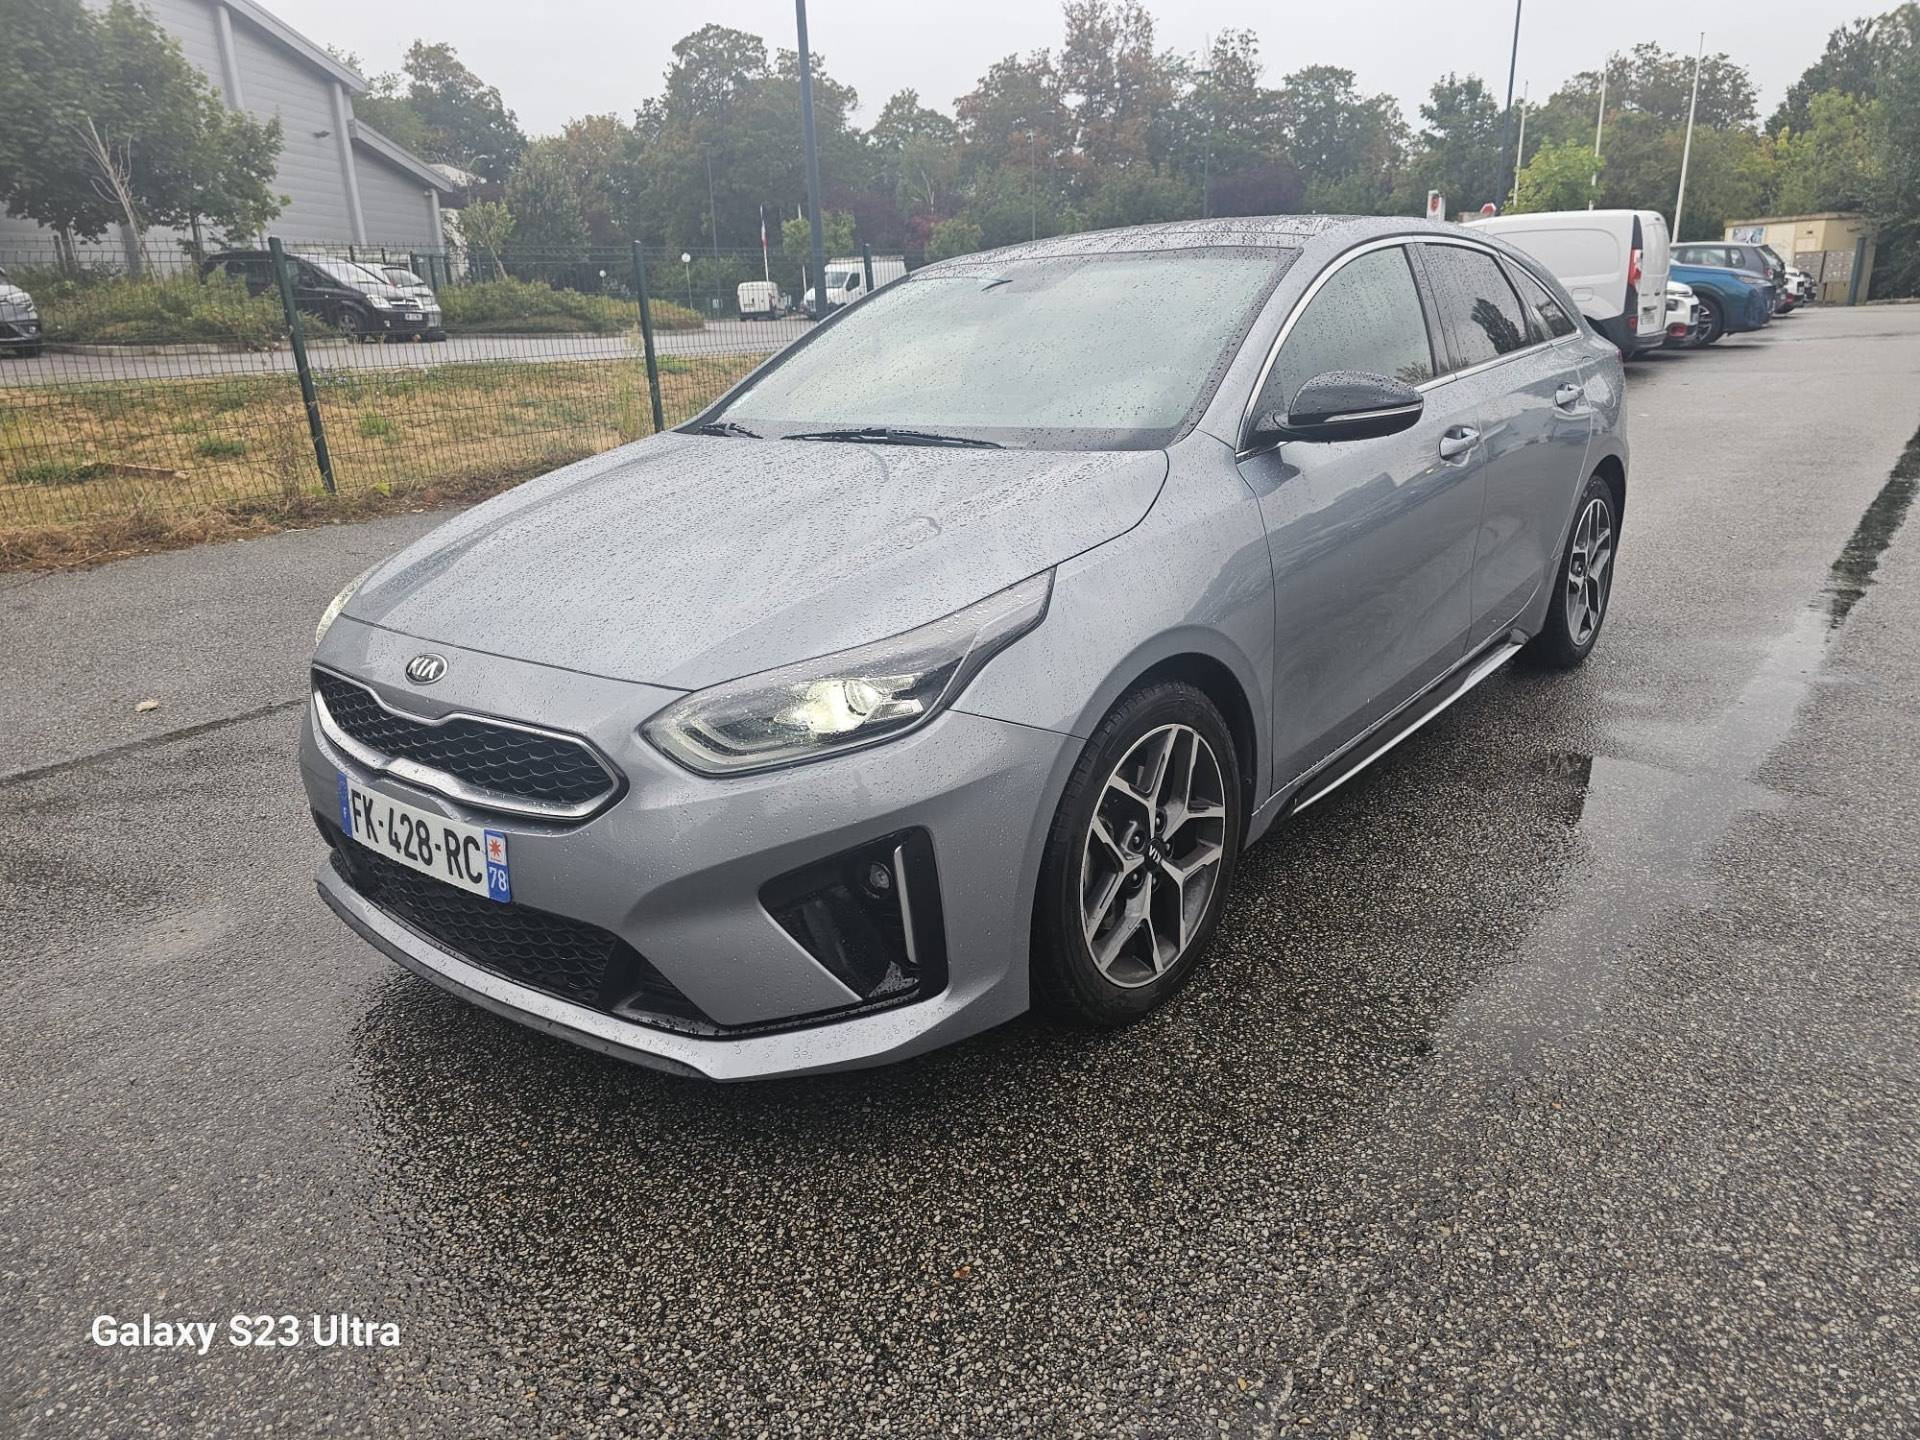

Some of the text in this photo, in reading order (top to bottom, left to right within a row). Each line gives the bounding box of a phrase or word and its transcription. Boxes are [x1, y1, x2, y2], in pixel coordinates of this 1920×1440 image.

[407, 656, 439, 680] KIA
[351, 788, 483, 885] FK-428-RC
[488, 866, 507, 892] 78
